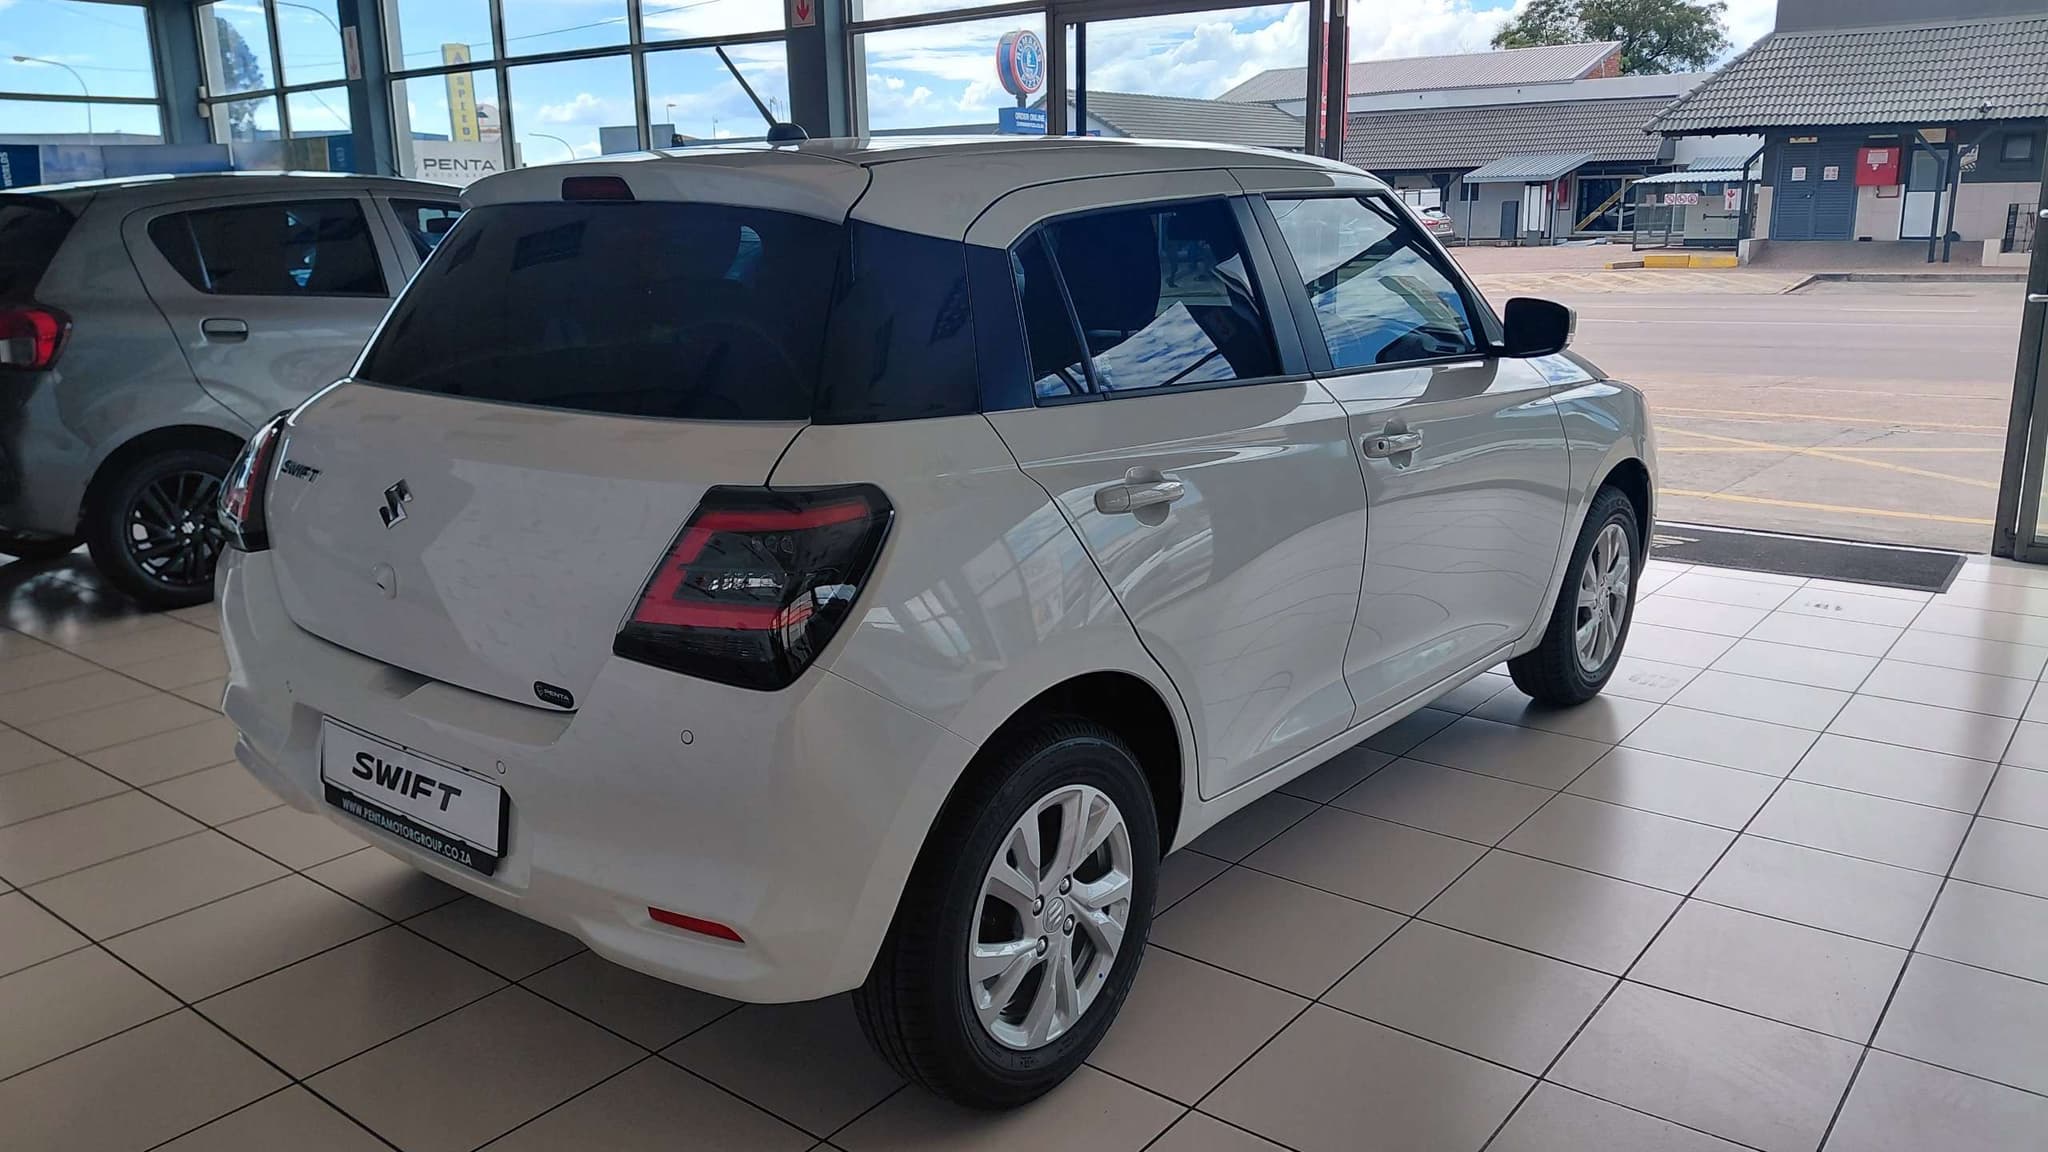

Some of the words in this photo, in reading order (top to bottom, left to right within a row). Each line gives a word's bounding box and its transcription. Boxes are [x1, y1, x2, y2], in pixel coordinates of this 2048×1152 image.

[1015, 112, 1030, 121] ORDER
[1030, 113, 1045, 122] ONLINE
[423, 159, 496, 171] PENTA
[281, 460, 320, 482] SWIFT
[543, 689, 570, 702] PENTA
[351, 751, 462, 812] SWIFT
[342, 797, 473, 867] WWW.PENTAMOTORGROUP.CO.ZA
